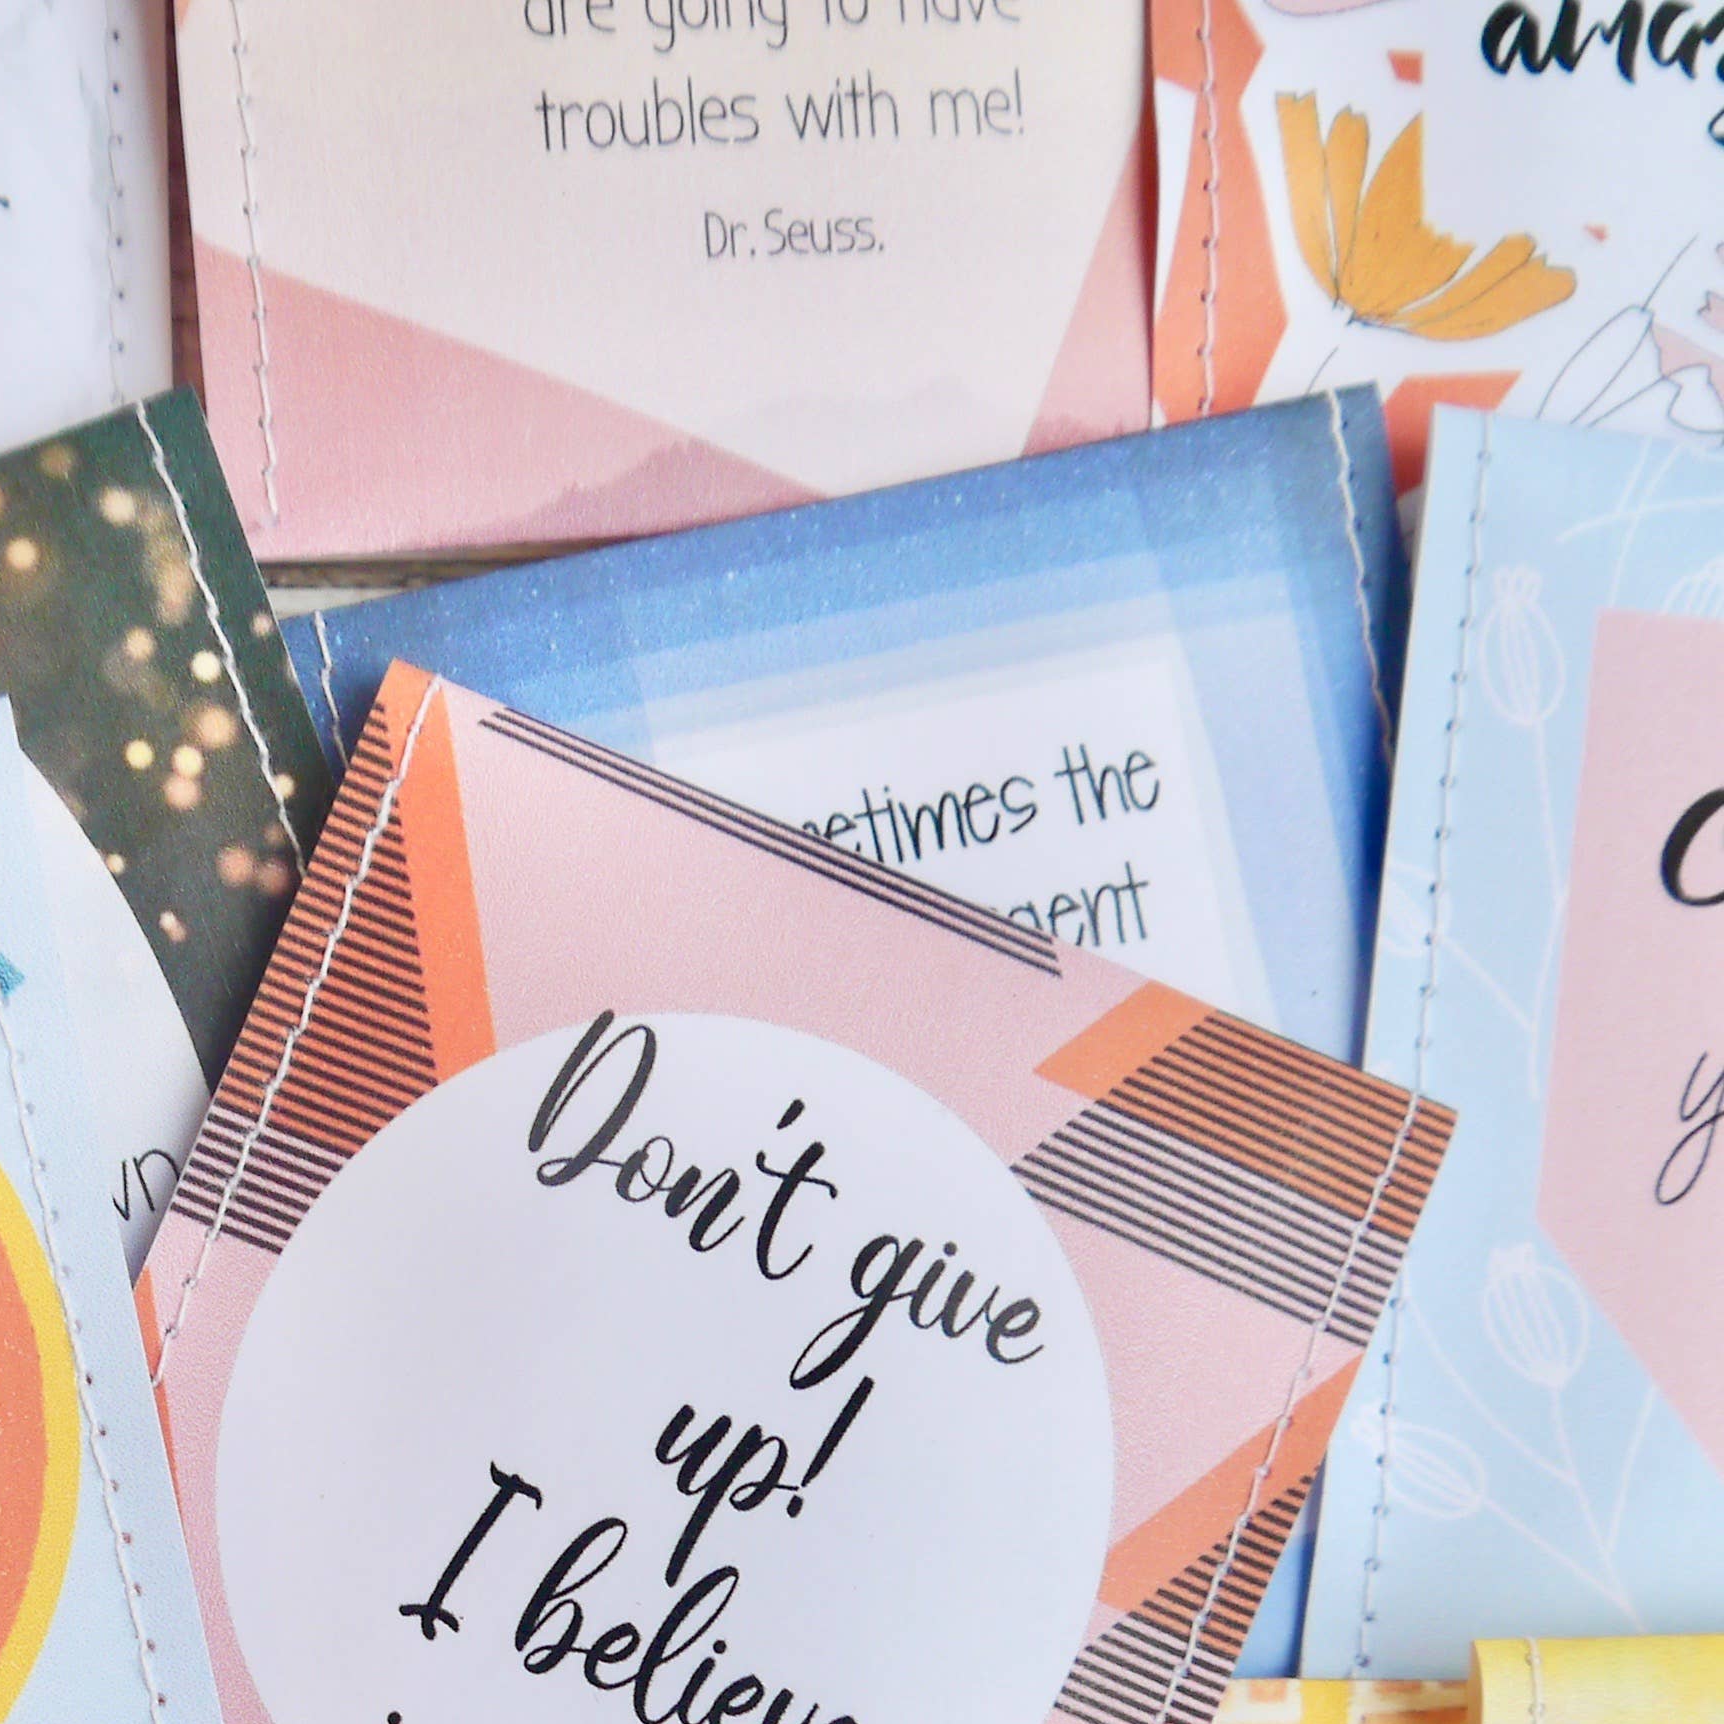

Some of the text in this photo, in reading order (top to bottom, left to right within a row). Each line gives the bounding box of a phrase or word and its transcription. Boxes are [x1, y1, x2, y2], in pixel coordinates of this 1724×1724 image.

[535, 68, 1024, 150] troubles with me!
[704, 208, 884, 257] Dr. Seuss.
[803, 744, 1160, 862] etimes the
[528, 1010, 1043, 1388] Don't give
[399, 1461, 541, 1640] I
[655, 1377, 874, 1584] up!
